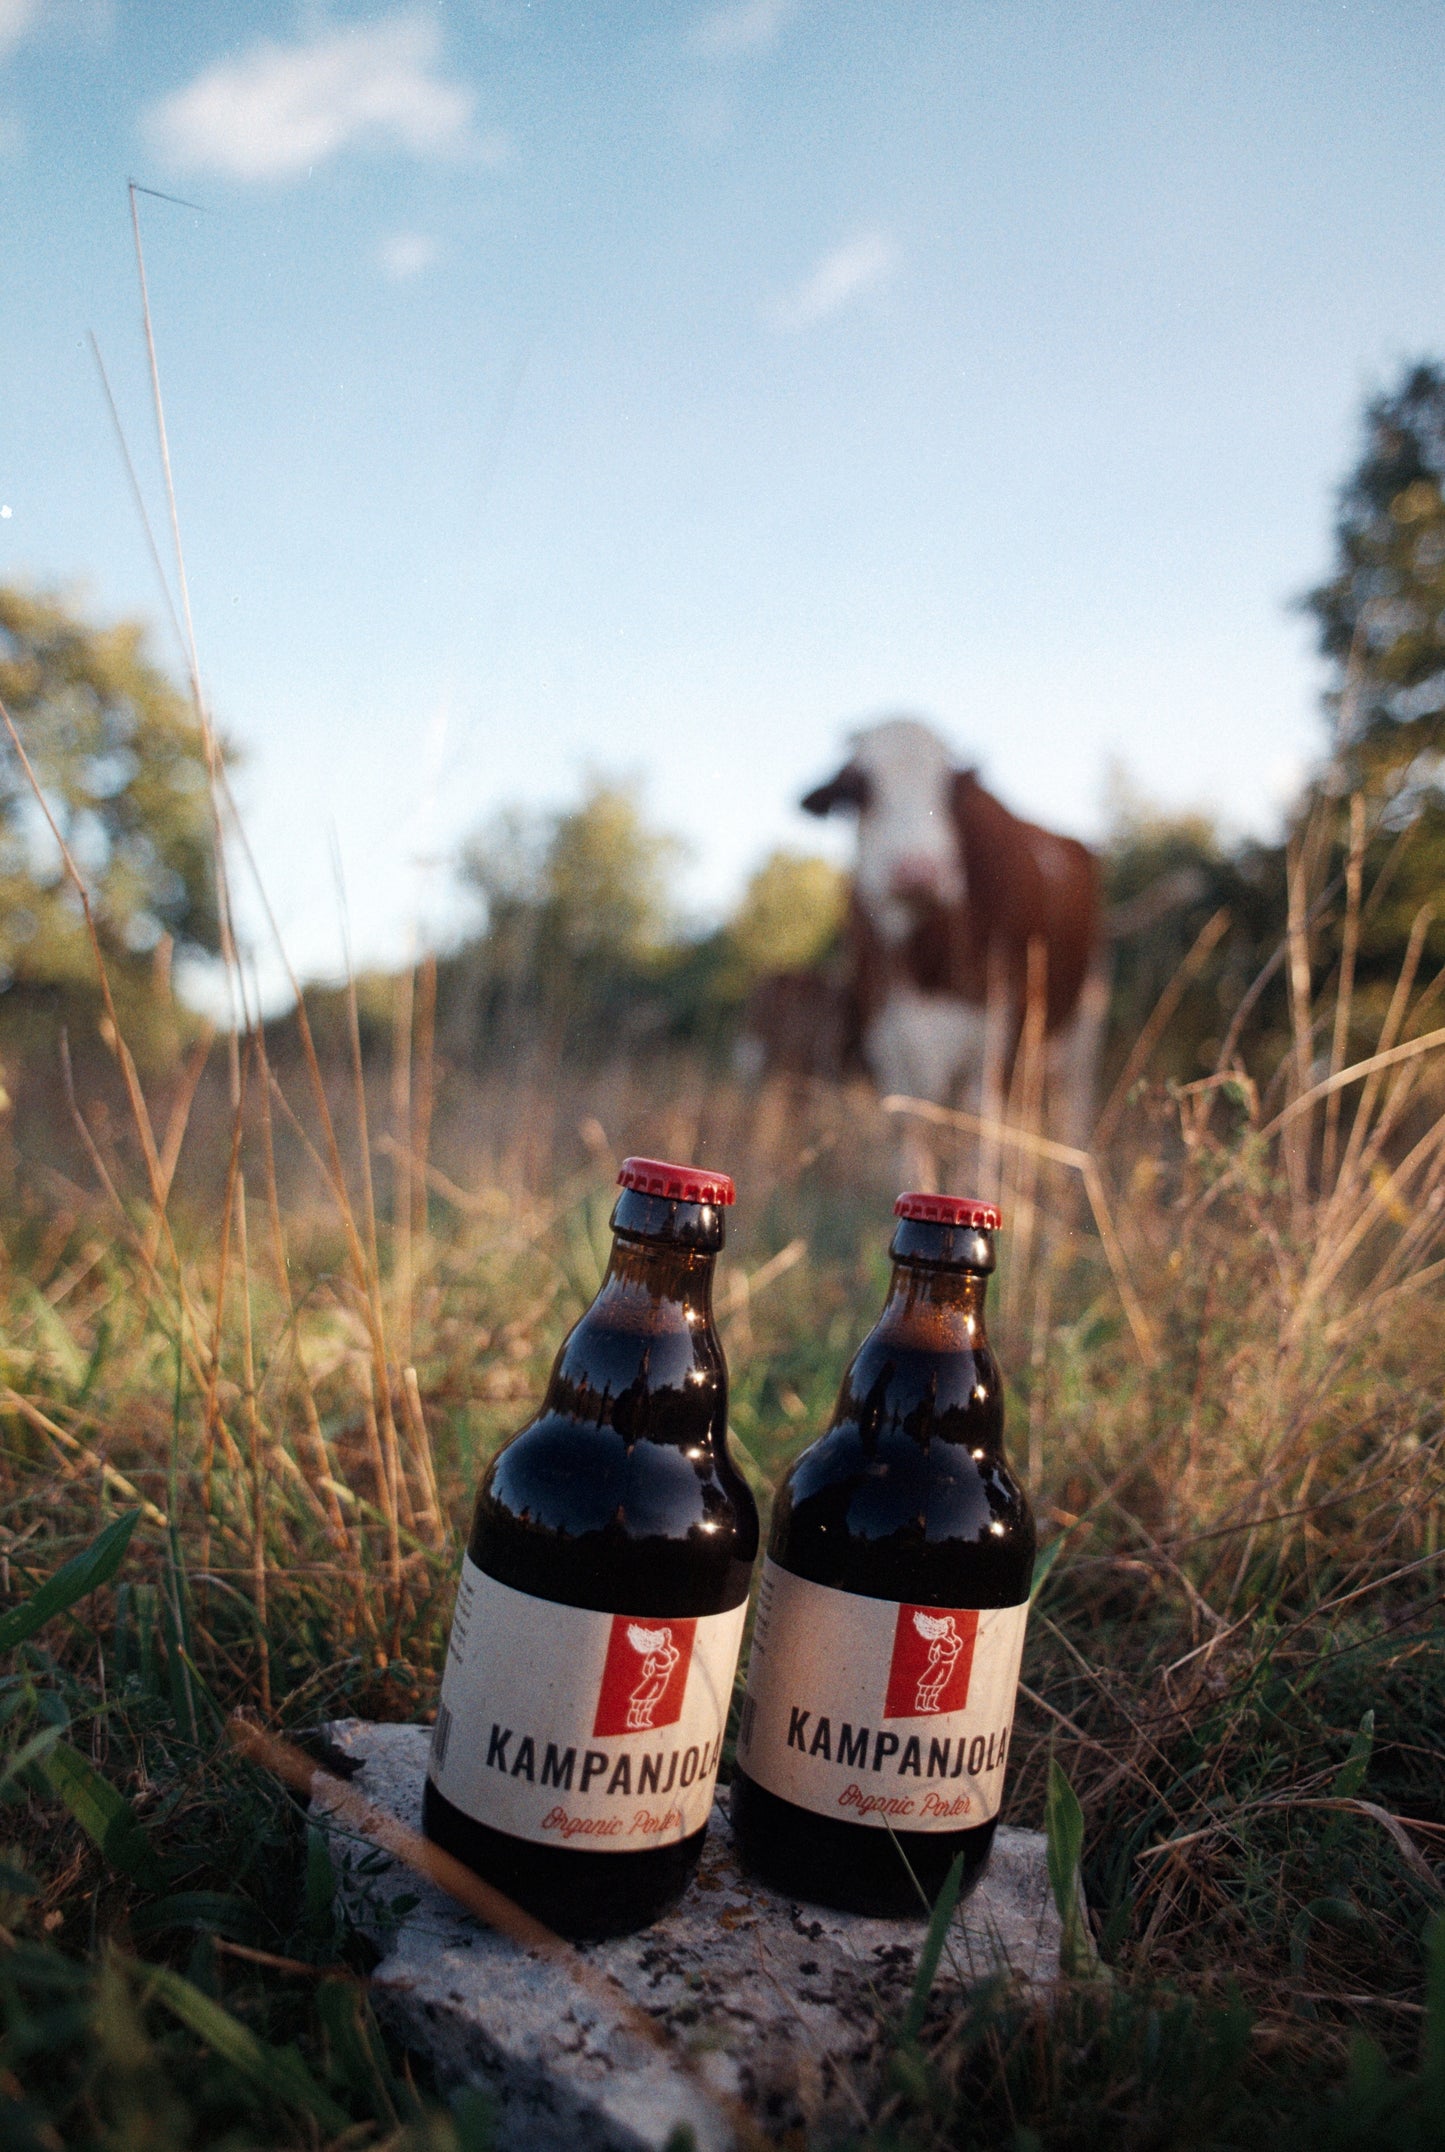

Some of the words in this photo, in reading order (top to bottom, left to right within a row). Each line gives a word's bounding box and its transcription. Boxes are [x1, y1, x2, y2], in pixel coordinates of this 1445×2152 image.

[486, 1723, 722, 1795] KAMPANJOLA
[787, 1706, 1007, 1778] KAMPANJOLA
[541, 1806, 622, 1838] Organic
[628, 1809, 681, 1835] Porter
[838, 1784, 914, 1816] Organic
[920, 1792, 971, 1817] Porter
